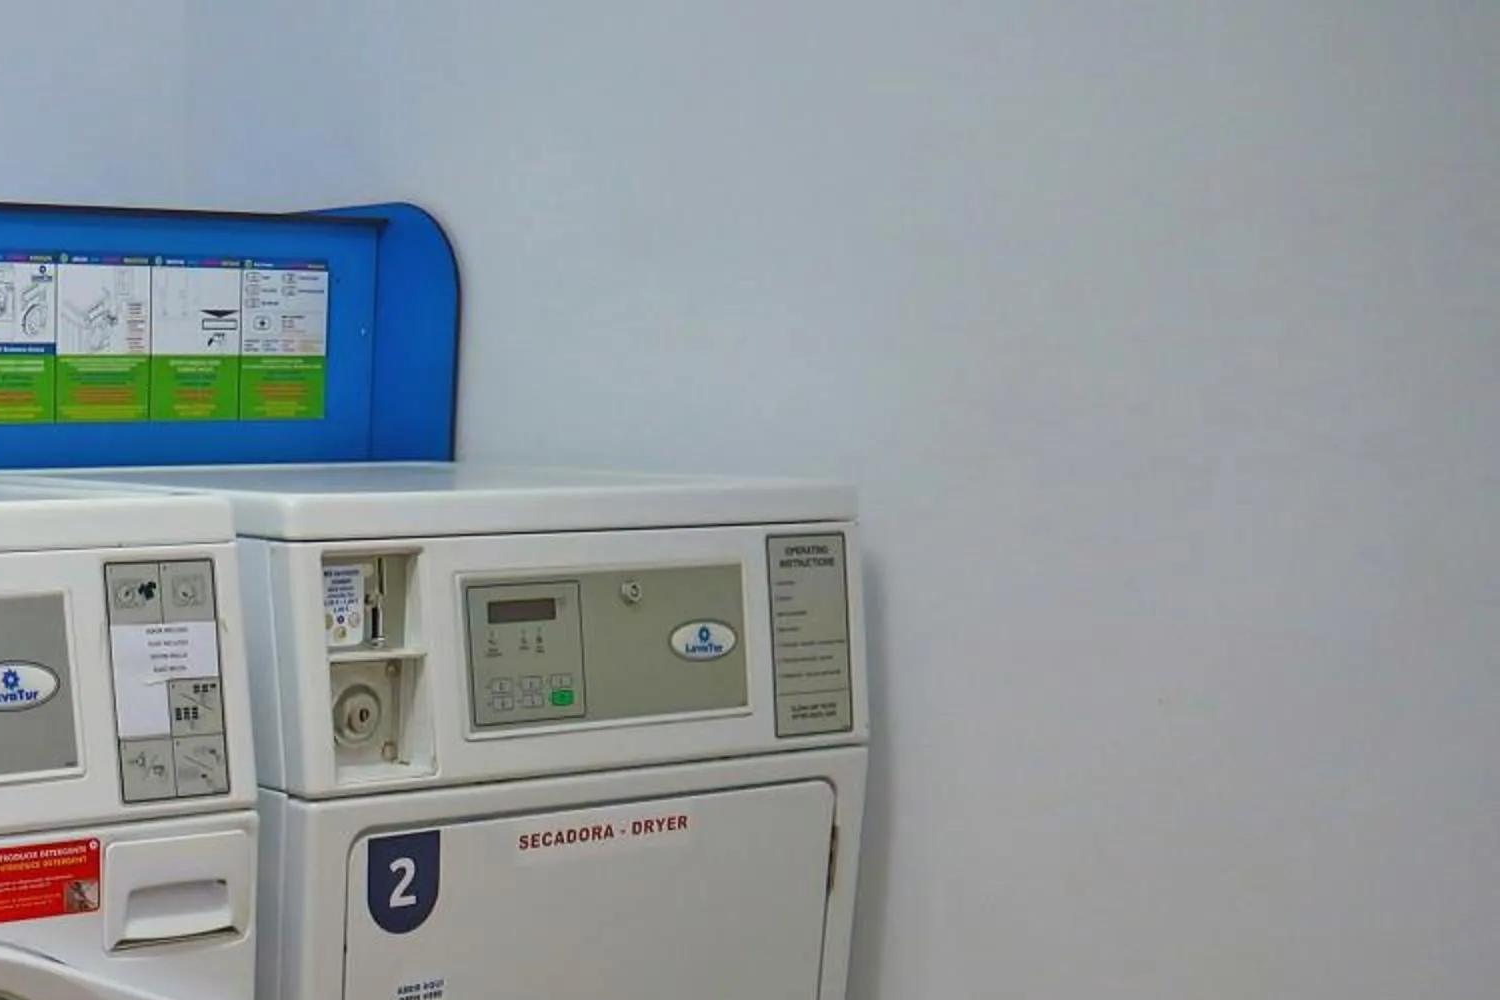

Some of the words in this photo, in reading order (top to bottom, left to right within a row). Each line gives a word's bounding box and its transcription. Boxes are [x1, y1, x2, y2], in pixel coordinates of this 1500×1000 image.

[519, 825, 615, 850] SECADORA
[631, 815, 689, 836] DRYER
[389, 857, 417, 908] 2
